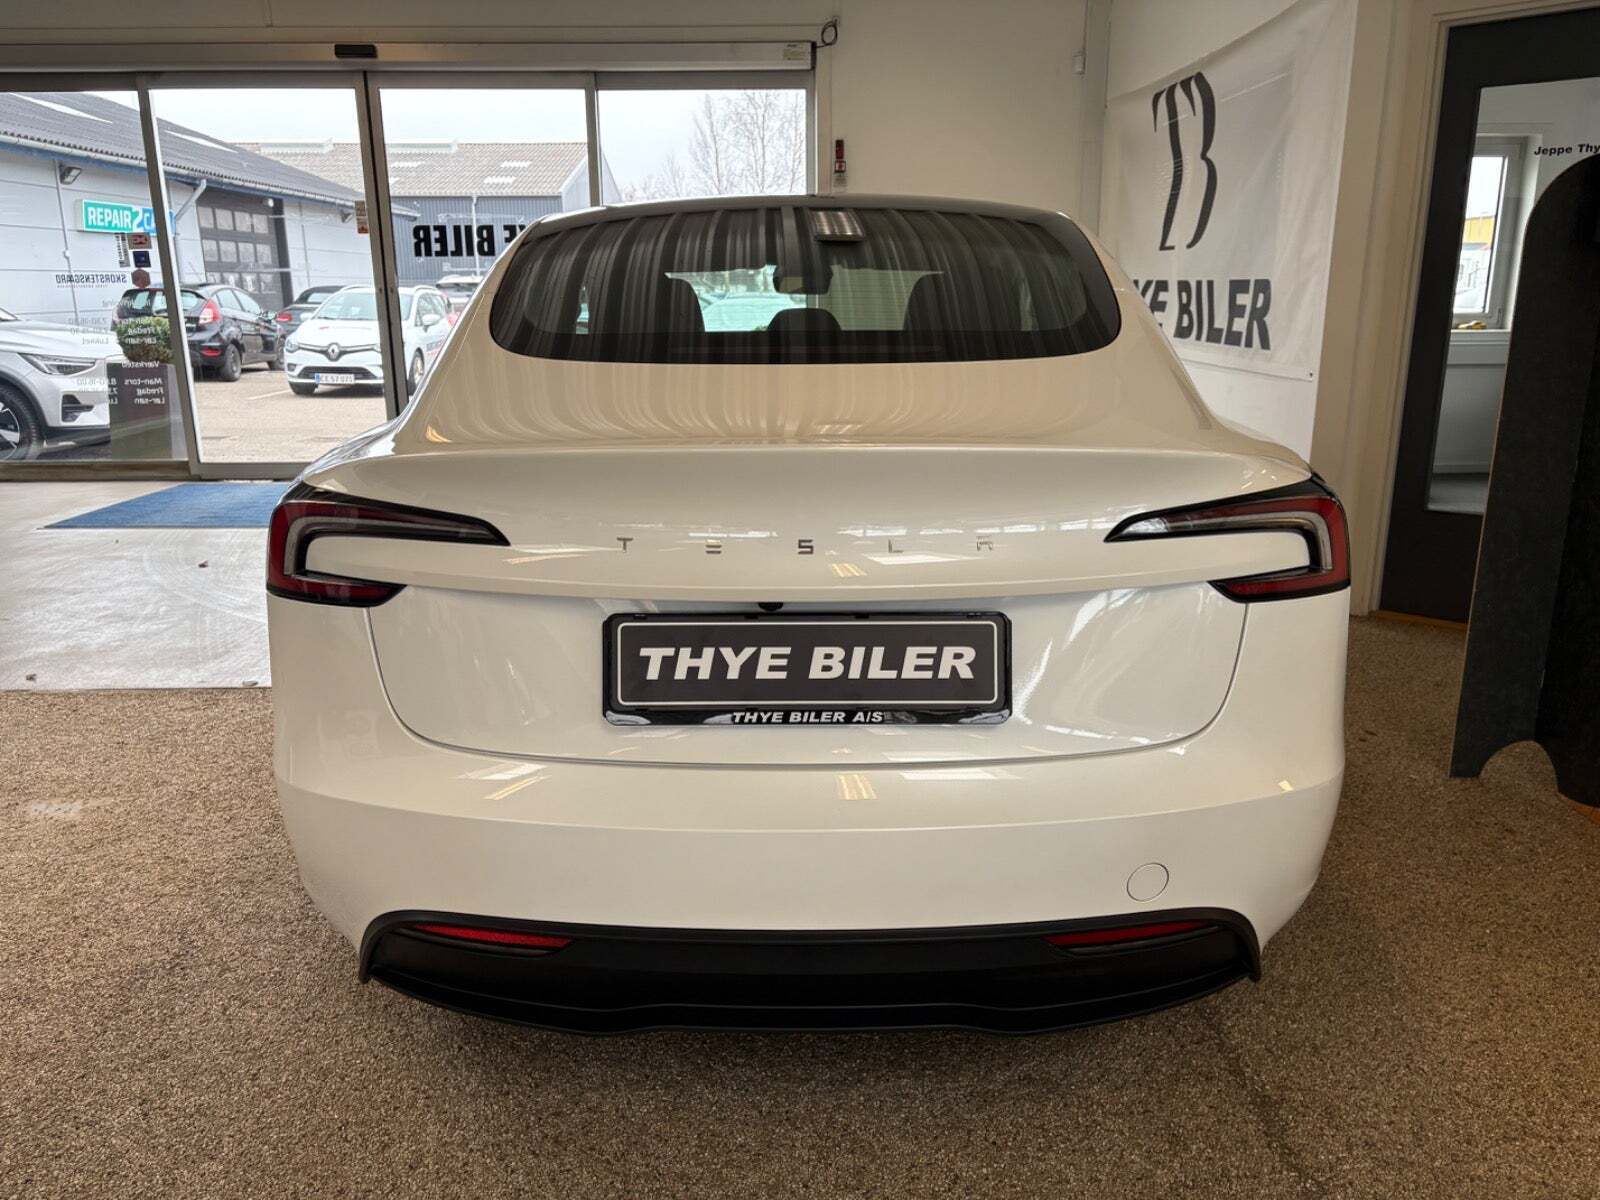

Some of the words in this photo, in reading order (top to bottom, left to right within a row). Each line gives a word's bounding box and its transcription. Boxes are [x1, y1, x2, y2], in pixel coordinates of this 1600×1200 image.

[1534, 145, 1573, 156] Jeppe
[1174, 279, 1272, 350] BILER
[617, 536, 994, 555] TESLA
[639, 647, 792, 680] THYE
[808, 646, 976, 680] BILER
[733, 712, 786, 724] THYE
[789, 711, 846, 723] BILER
[853, 711, 884, 723] A/S
